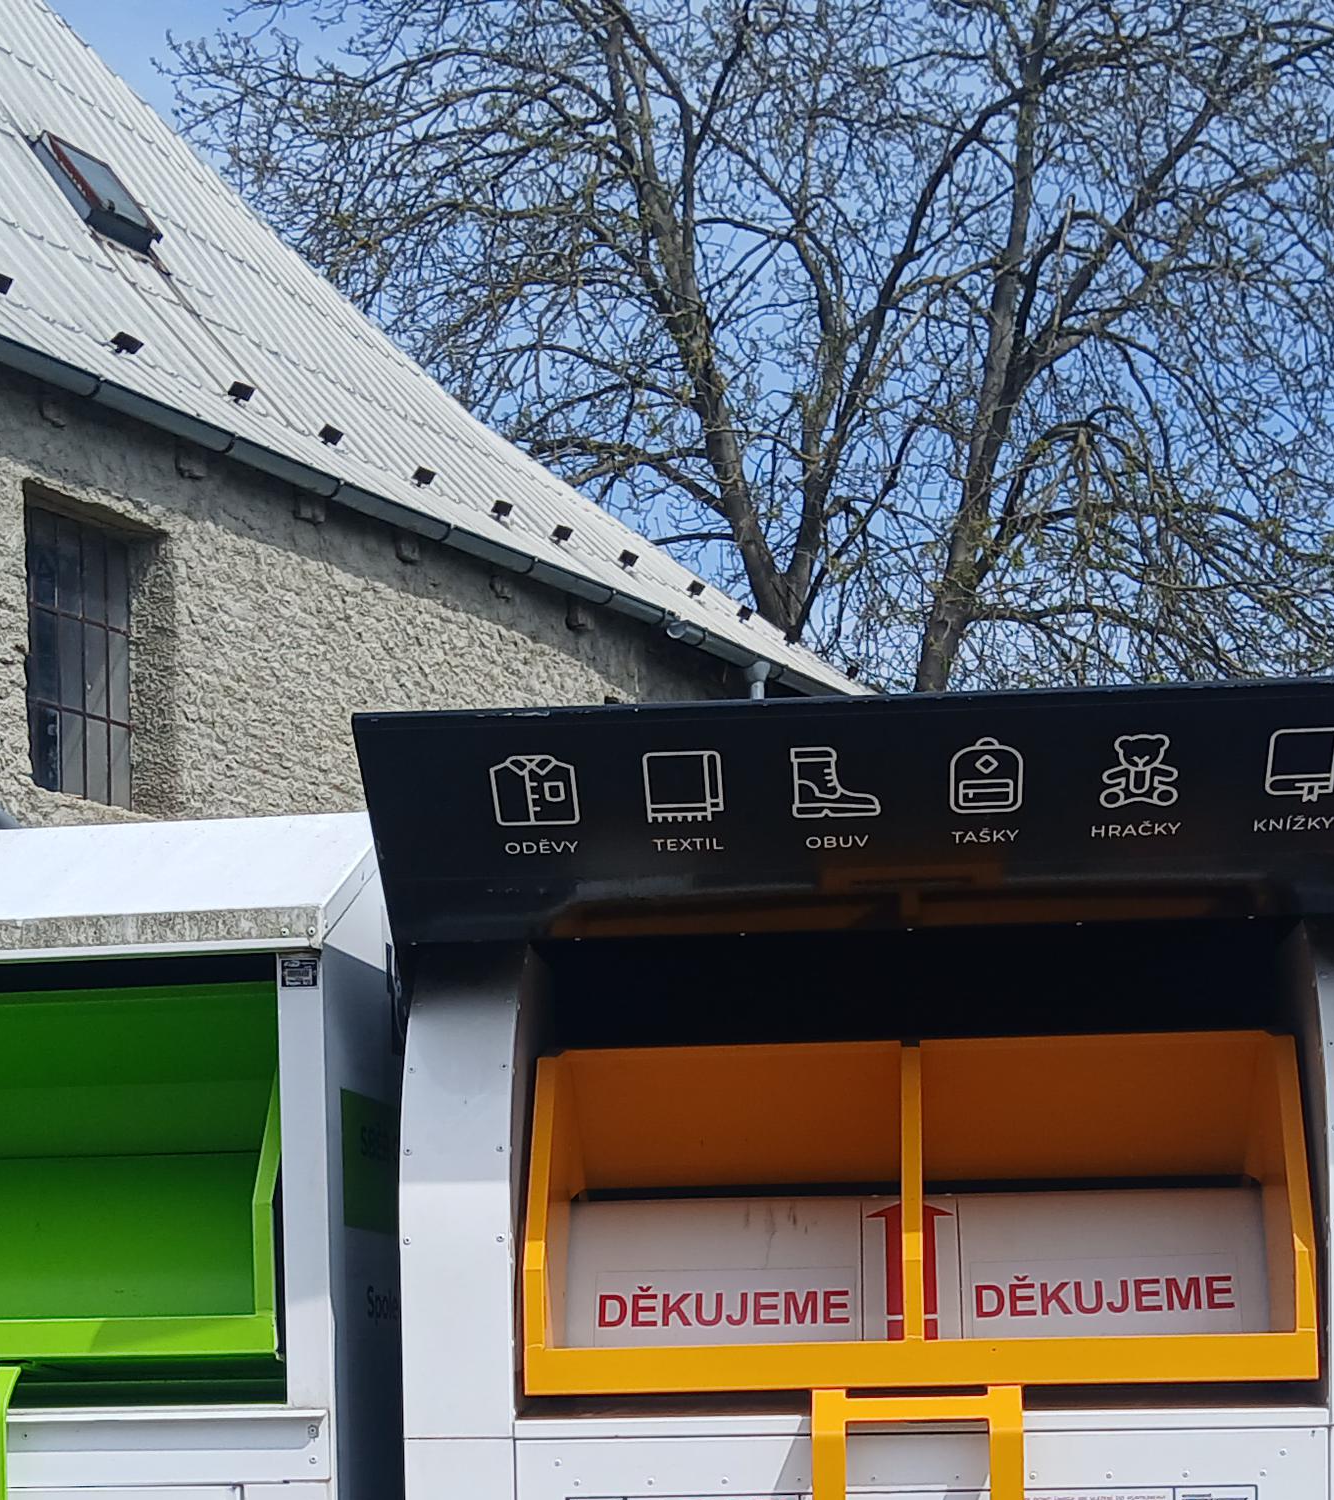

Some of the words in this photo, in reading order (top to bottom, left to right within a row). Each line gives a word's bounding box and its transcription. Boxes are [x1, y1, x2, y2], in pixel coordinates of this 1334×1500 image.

[1091, 820, 1181, 839] HRAČKY
[1253, 814, 1334, 833] KNÍŽKY
[652, 837, 724, 852] TEXTIL
[805, 834, 869, 849] OBUV
[951, 827, 1019, 844] TAŠKY
[504, 838, 578, 855] ODĚVY
[974, 1275, 1236, 1319] DĚKUJEME
[597, 1285, 851, 1329] DĚKUJEME
